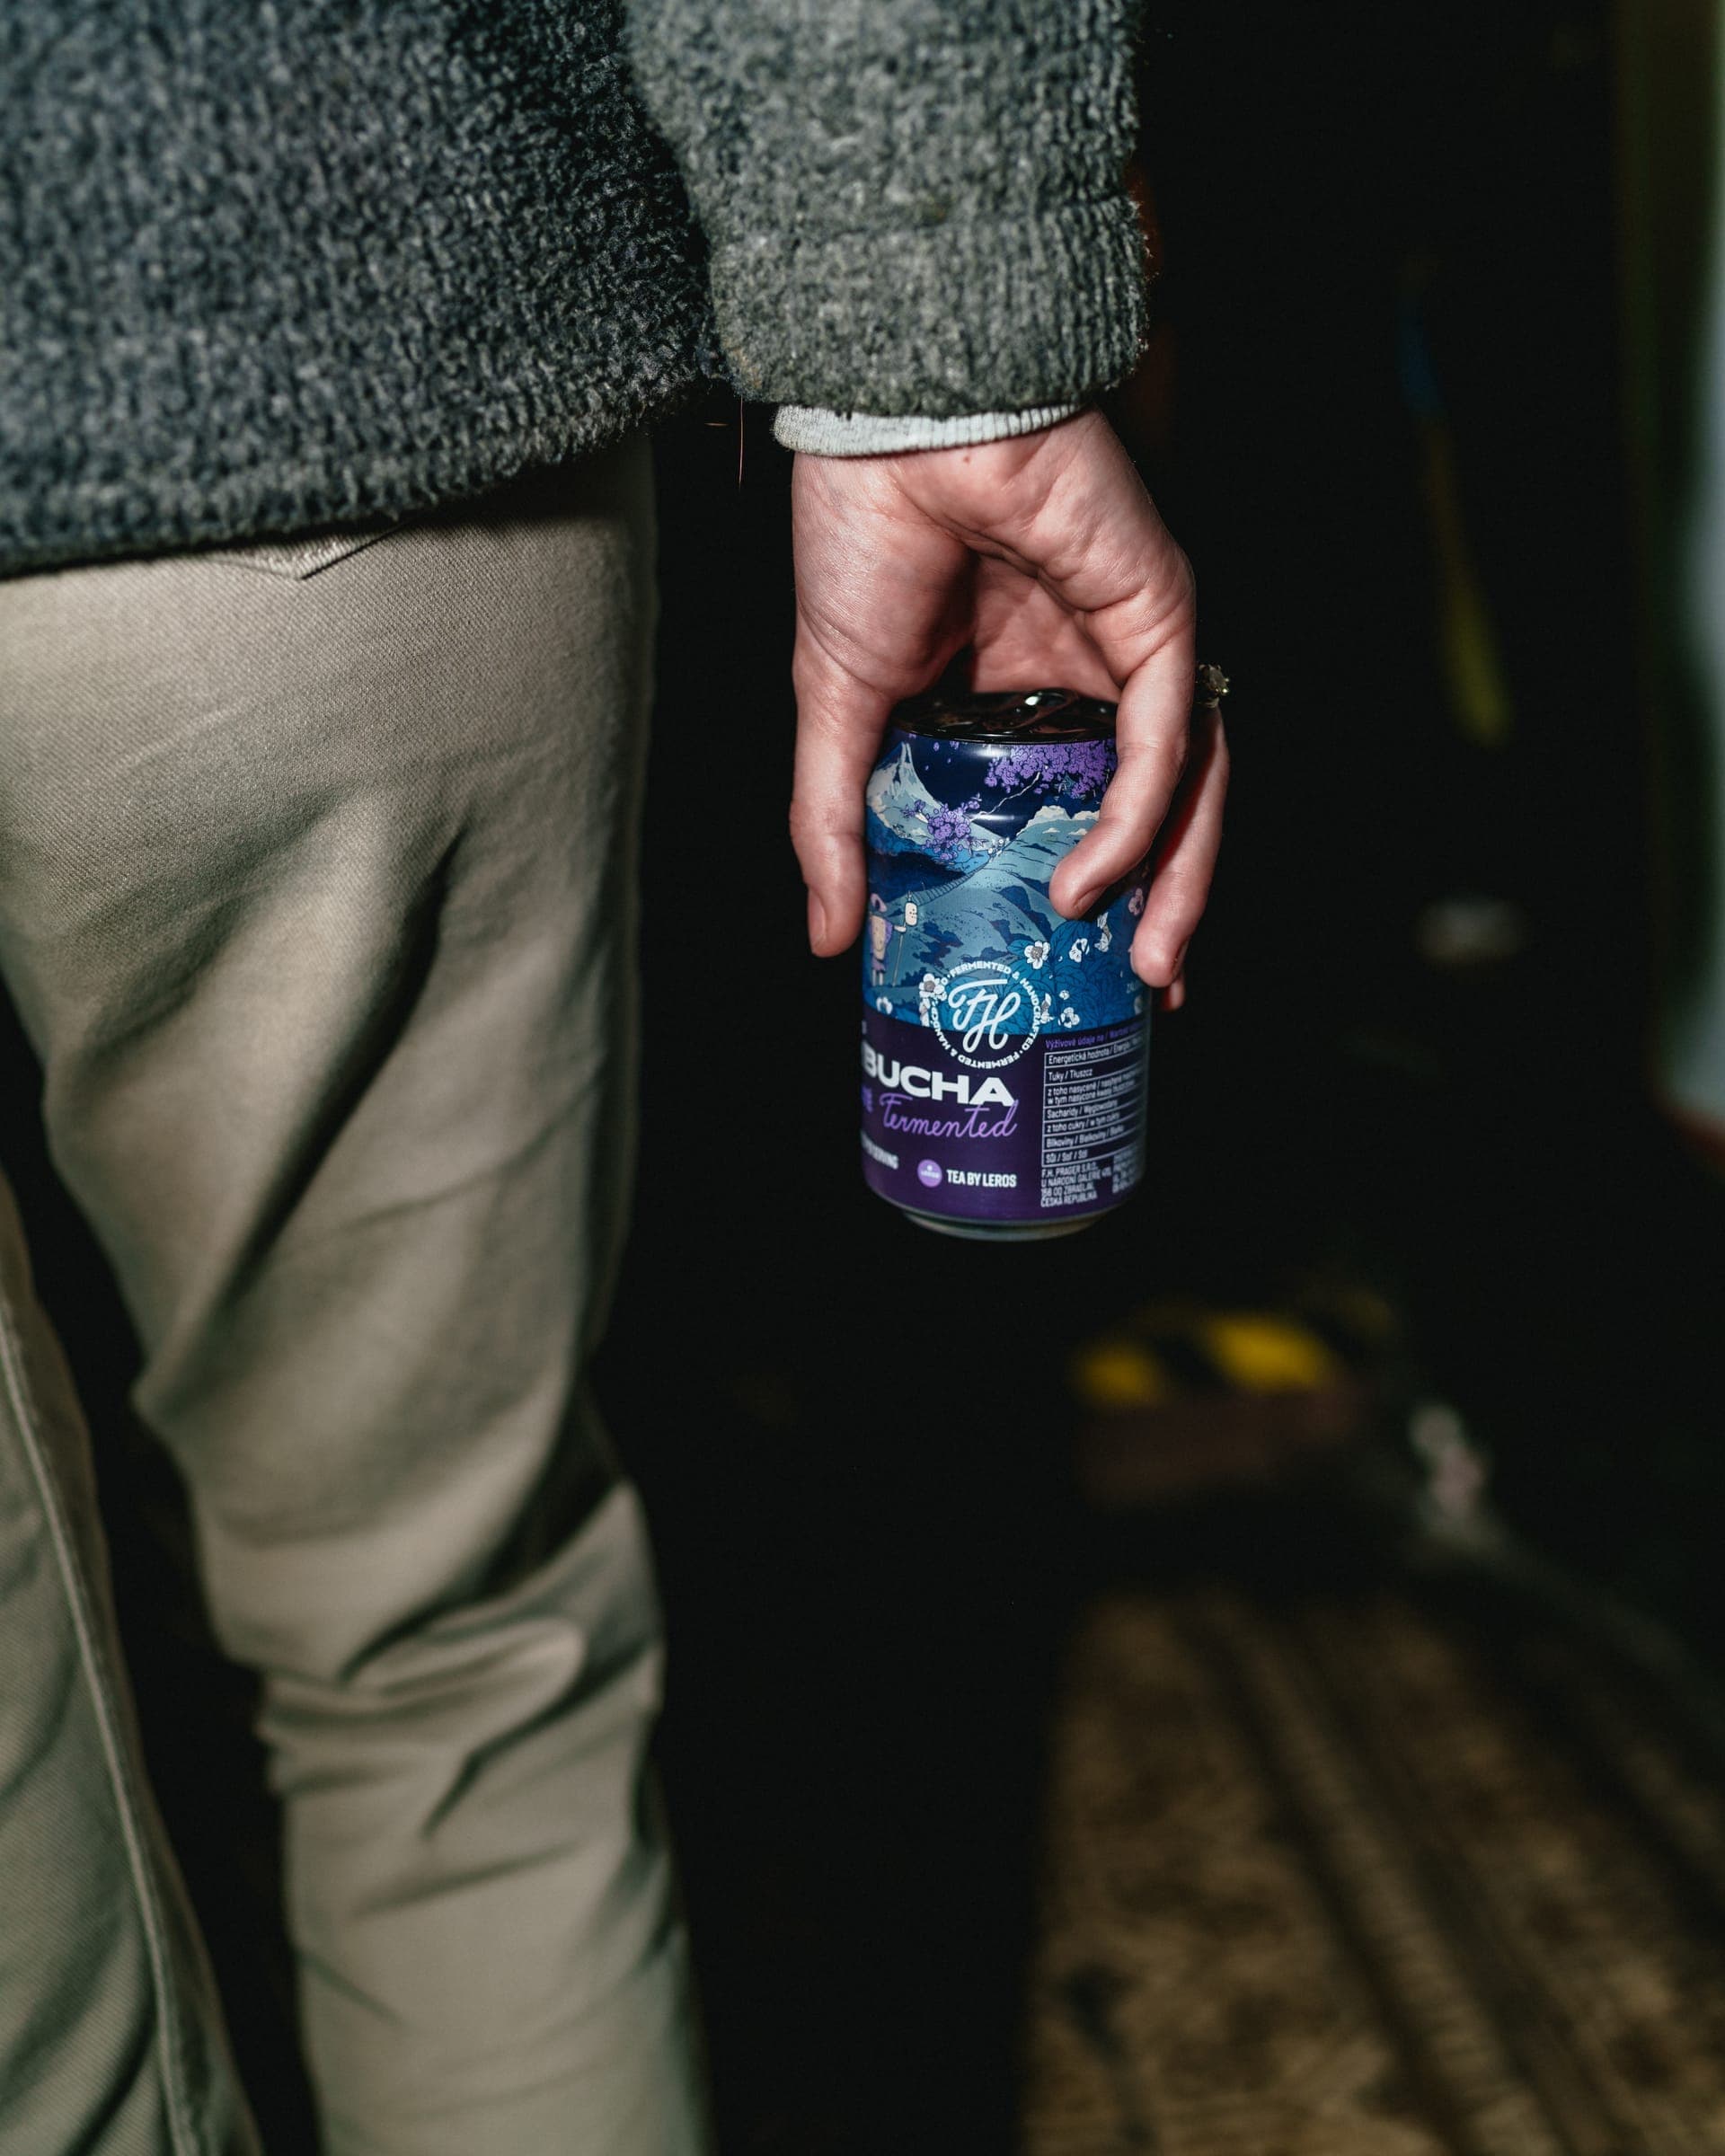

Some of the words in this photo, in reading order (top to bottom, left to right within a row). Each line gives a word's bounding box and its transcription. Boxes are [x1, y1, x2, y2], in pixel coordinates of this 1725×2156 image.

[950, 960, 1012, 977] FERMENTED
[1013, 972, 1020, 980] &
[1019, 978, 1040, 1050] HANDCRAFTED
[958, 1052, 1020, 1069] FERMENTED
[1048, 1071, 1064, 1082] Tuky
[880, 1092, 1019, 1138] Fermented
[946, 1169, 966, 1185] TEA
[967, 1171, 981, 1186] BY
[982, 1173, 1017, 1188] LEROS
